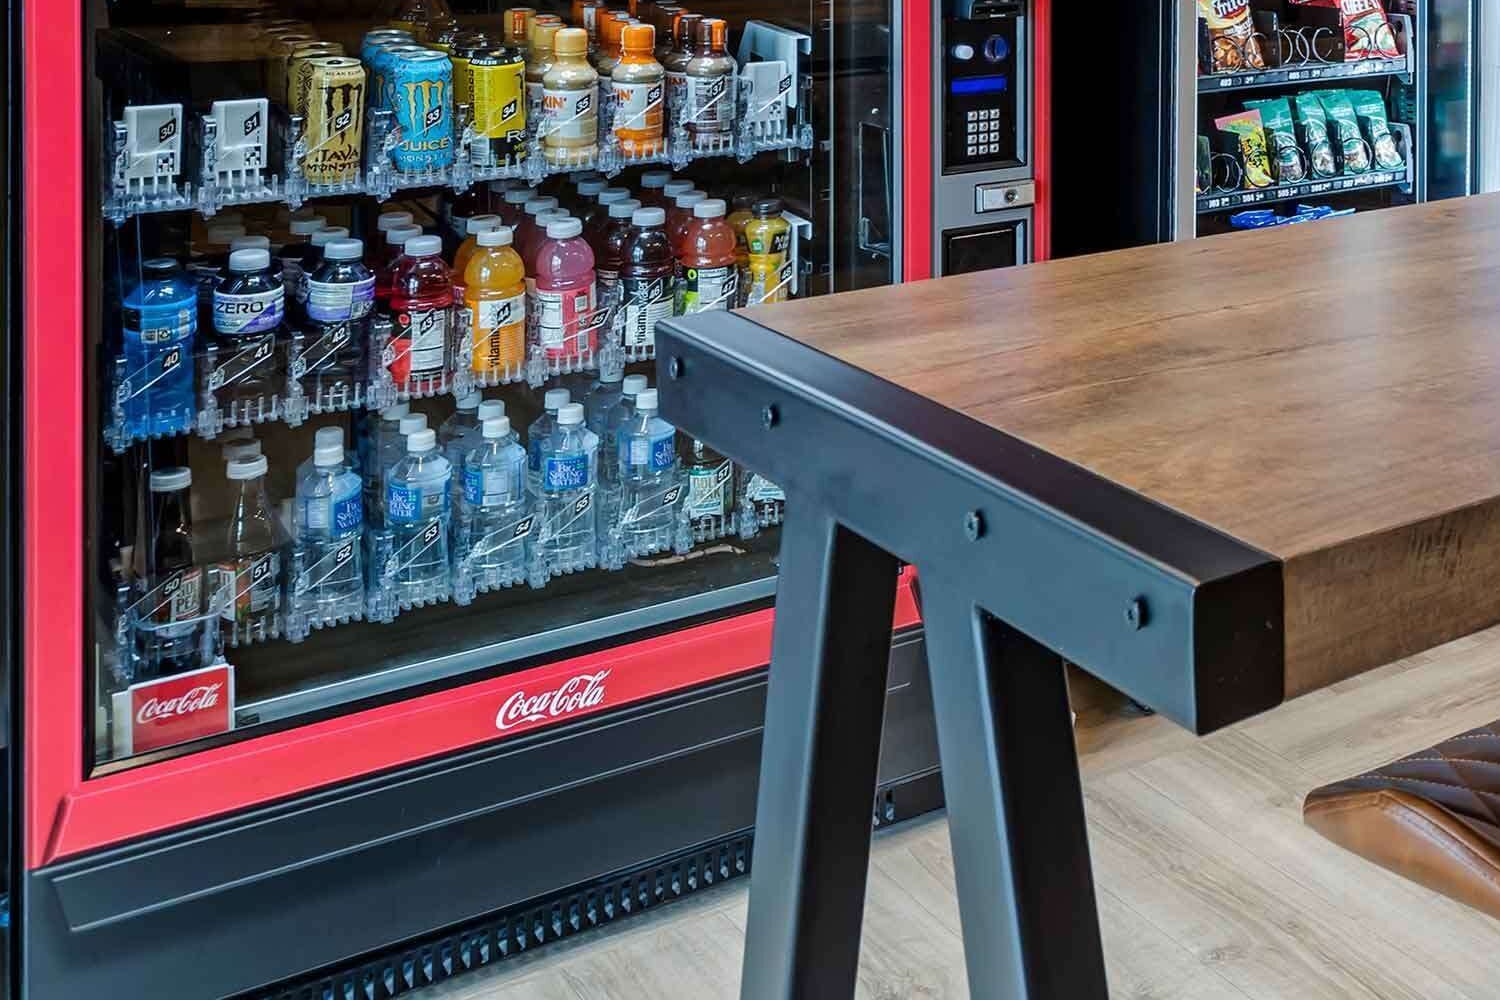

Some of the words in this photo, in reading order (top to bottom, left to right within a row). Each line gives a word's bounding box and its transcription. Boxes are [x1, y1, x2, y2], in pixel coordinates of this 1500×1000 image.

[648, 86, 660, 101] 36
[711, 79, 724, 96] 37
[576, 96, 589, 112] 35
[336, 112, 350, 128] 32
[426, 108, 440, 124] 33
[502, 105, 515, 120] 34
[159, 122, 174, 140] 30
[244, 115, 258, 133] 31
[401, 137, 449, 151] JUICE
[649, 287, 659, 299] 46
[722, 279, 735, 294] 47
[214, 300, 264, 315] ZERO
[421, 318, 433, 334] 43
[332, 327, 345, 344] 42
[255, 343, 268, 358] 41
[164, 351, 178, 368] 40
[717, 466, 729, 481] 57
[664, 490, 677, 503] 56
[576, 497, 589, 513] 55
[425, 526, 438, 542] 53
[515, 520, 529, 535] 54
[337, 544, 351, 562] 52
[254, 561, 268, 578] 51
[164, 579, 178, 595] 50
[136, 682, 222, 725] Coca-Cola
[495, 667, 613, 730] Coca-Cola
